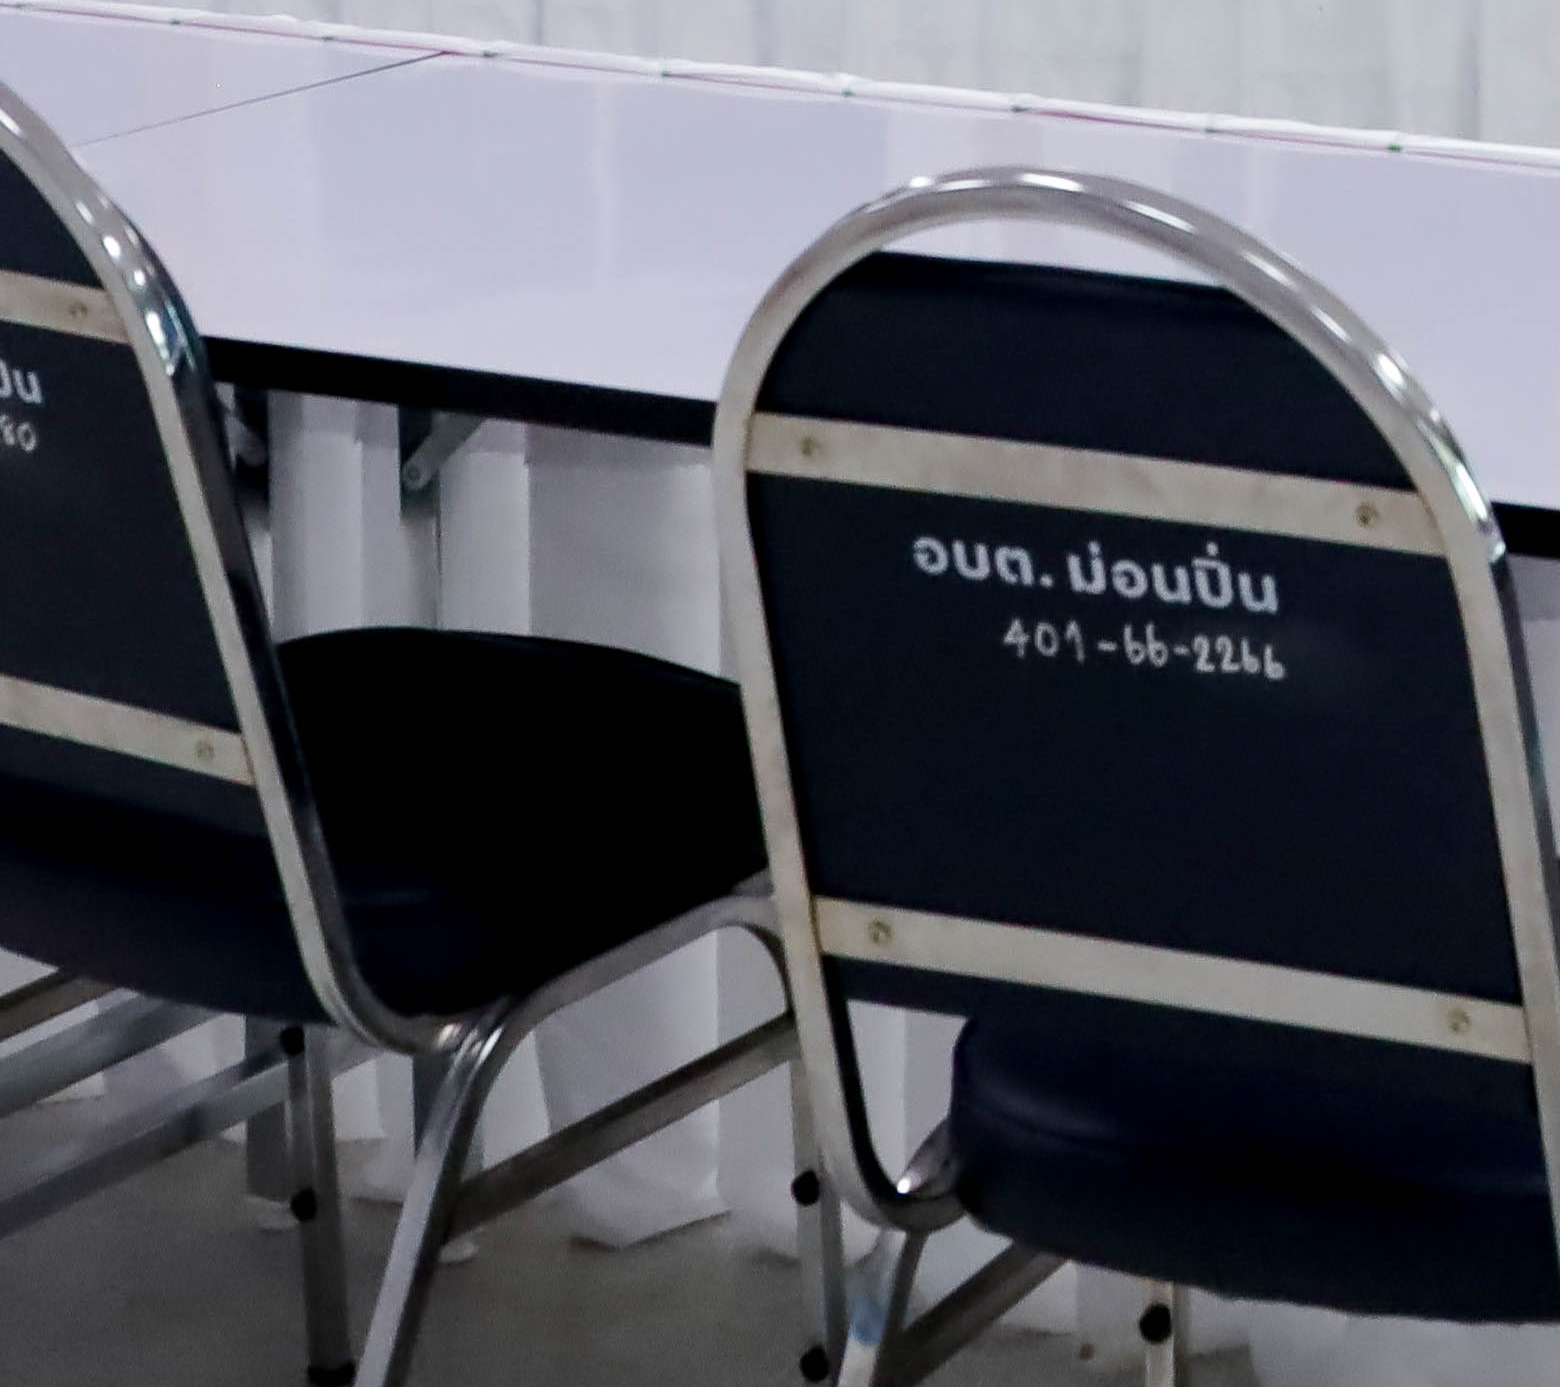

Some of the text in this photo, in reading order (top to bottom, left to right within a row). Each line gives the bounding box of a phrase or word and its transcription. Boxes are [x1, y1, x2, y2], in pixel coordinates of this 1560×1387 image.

[913, 536, 1280, 614] อบต. ม่อนปิ่น
